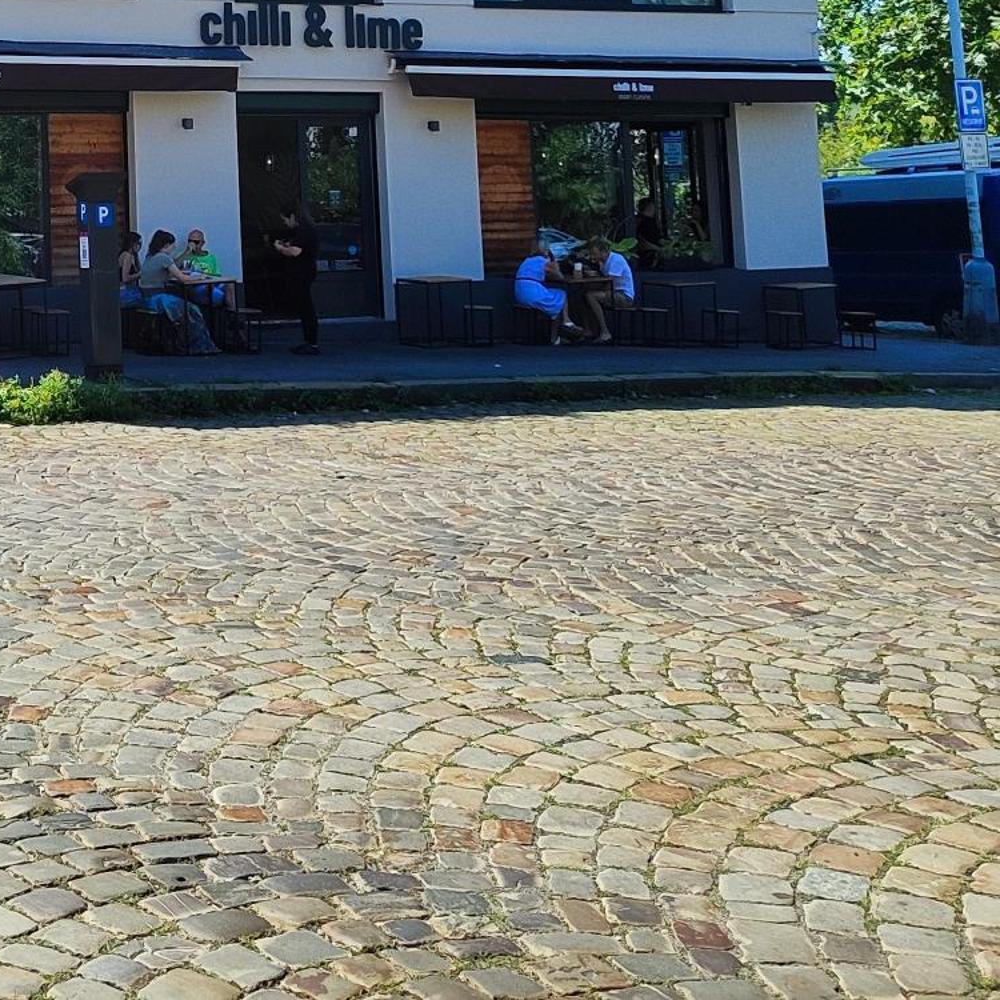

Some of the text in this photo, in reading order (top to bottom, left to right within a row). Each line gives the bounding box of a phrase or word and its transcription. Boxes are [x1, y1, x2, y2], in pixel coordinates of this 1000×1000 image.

[200, 1, 424, 50] chilli & lime
[961, 86, 977, 115] P
[99, 206, 109, 224] P
